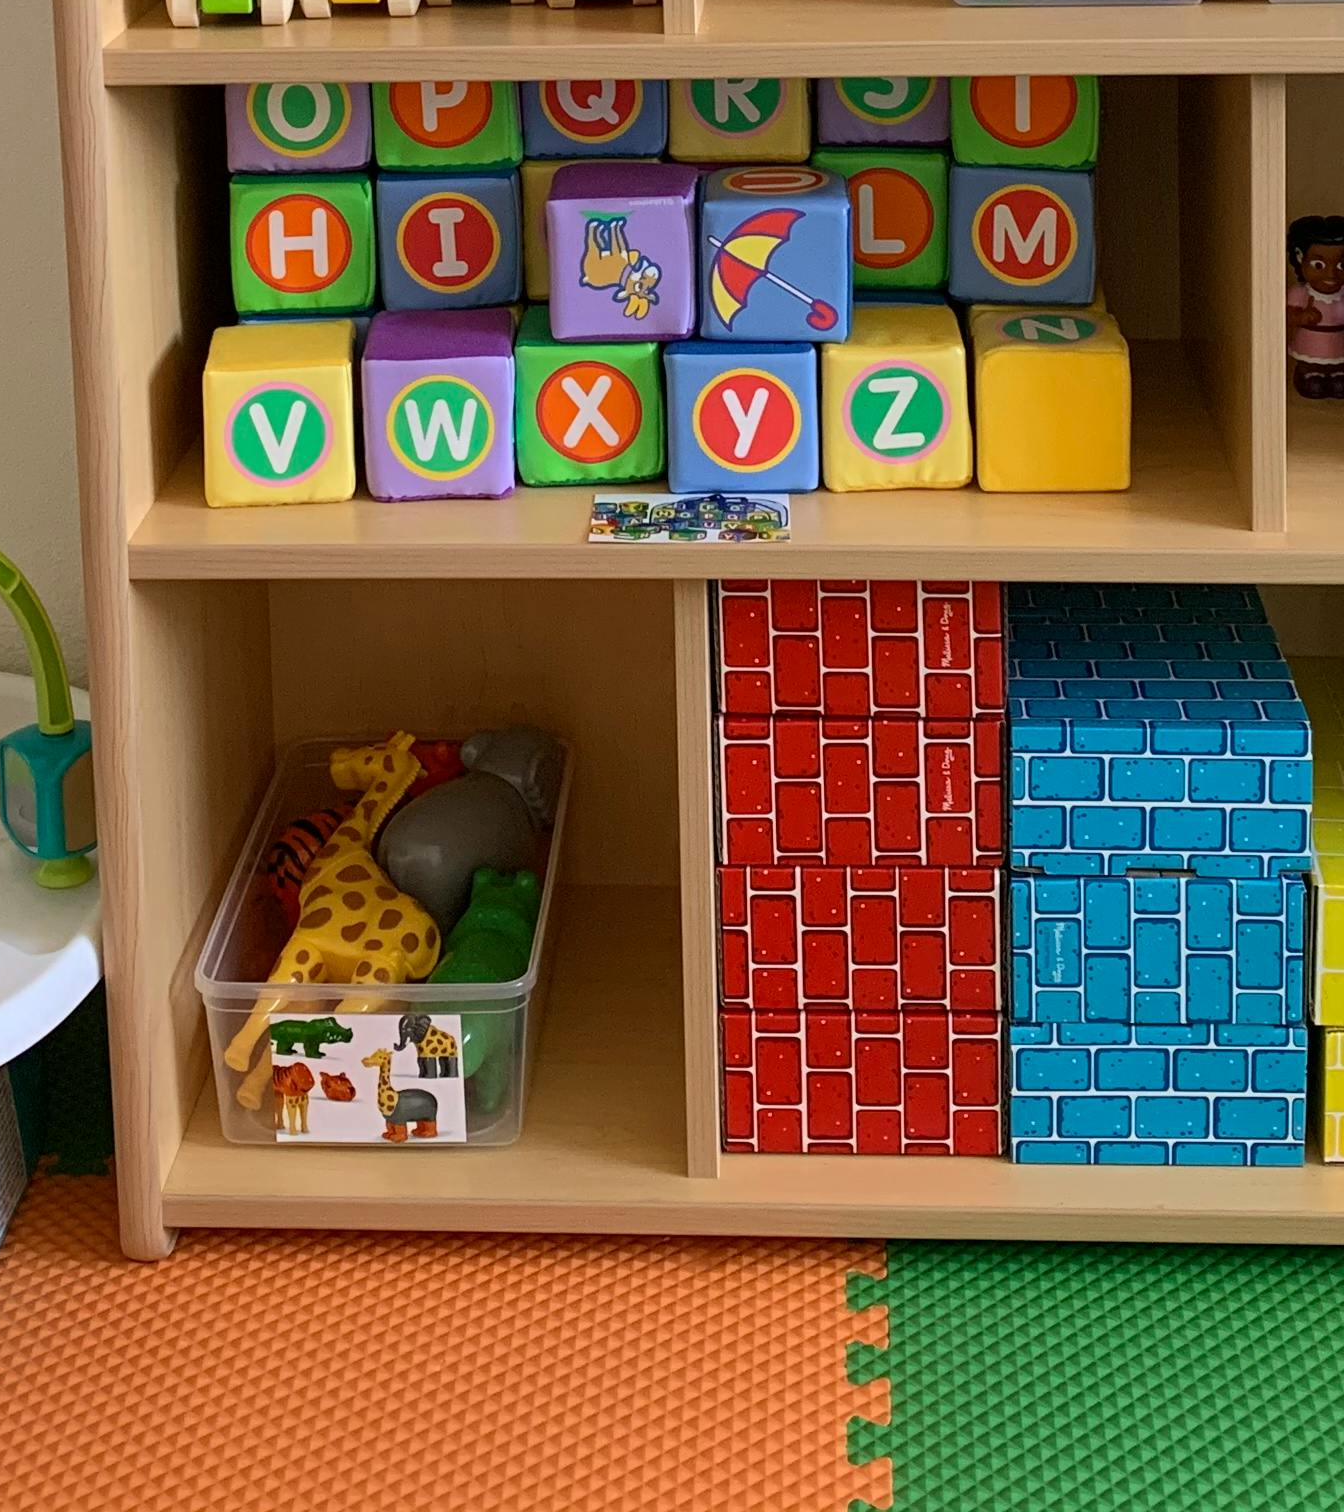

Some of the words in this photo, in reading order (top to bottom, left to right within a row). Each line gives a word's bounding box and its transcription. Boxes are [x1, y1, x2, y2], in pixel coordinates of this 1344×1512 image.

[421, 80, 468, 133] P
[556, 79, 619, 126] Q
[267, 206, 330, 280] H
[427, 206, 469, 278] I
[858, 183, 907, 255] L
[992, 203, 1058, 267] M
[1020, 317, 1082, 341] N
[248, 399, 308, 475] V
[403, 397, 478, 463] W
[560, 374, 622, 450] X
[866, 374, 926, 451] Z
